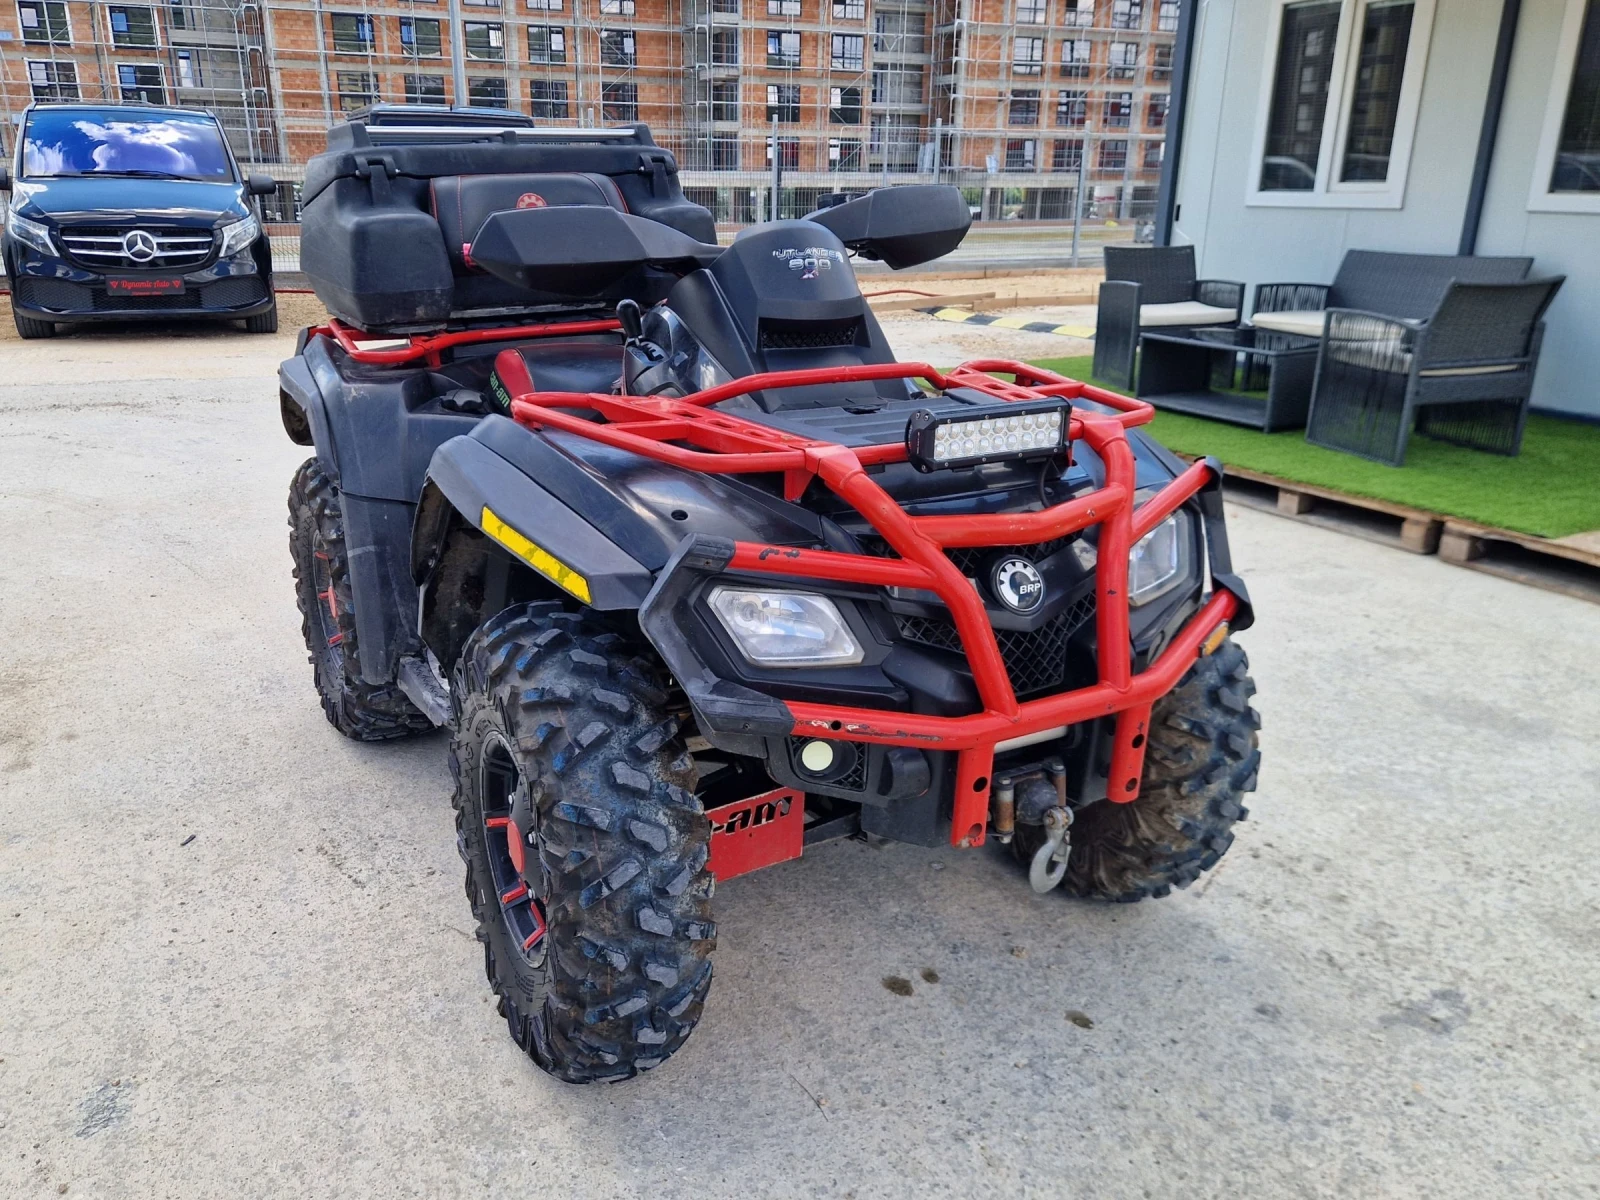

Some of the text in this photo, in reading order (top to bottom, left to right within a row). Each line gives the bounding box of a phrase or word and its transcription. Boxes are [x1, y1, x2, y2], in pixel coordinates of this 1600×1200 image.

[788, 258, 832, 271] 800
[121, 280, 170, 290] Dynamic Auto
[1019, 582, 1041, 595] BRP
